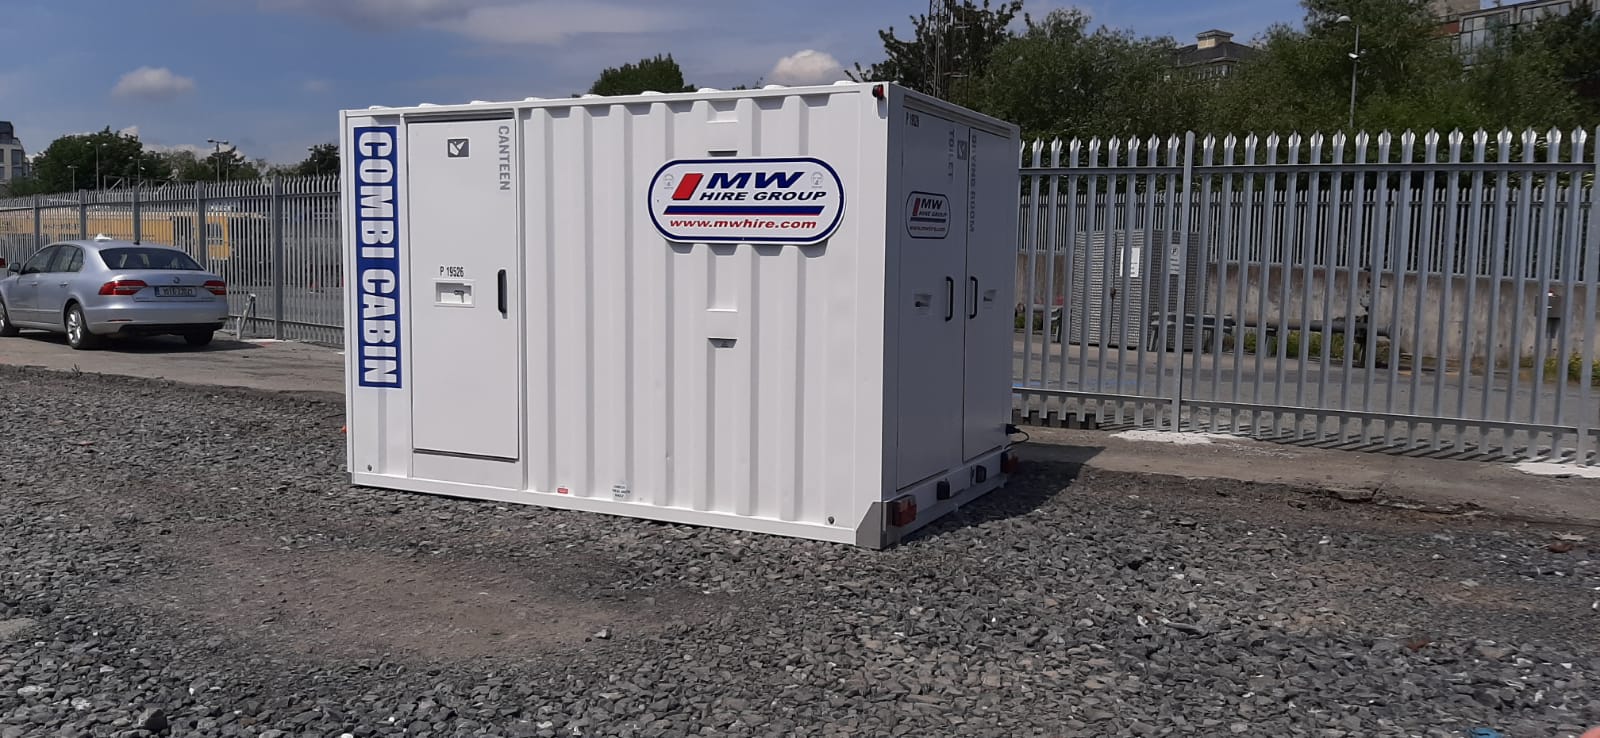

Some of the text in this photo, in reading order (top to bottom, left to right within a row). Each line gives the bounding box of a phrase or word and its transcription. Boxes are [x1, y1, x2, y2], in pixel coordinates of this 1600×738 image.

[498, 125, 510, 191] CANTEEN
[706, 171, 805, 189] MW
[699, 191, 827, 201] HIRE GROUP
[921, 197, 943, 210] MW
[669, 218, 817, 229] www.mwhire.com
[358, 131, 398, 384] COMBI CABIN
[439, 265, 465, 278] P 19526
